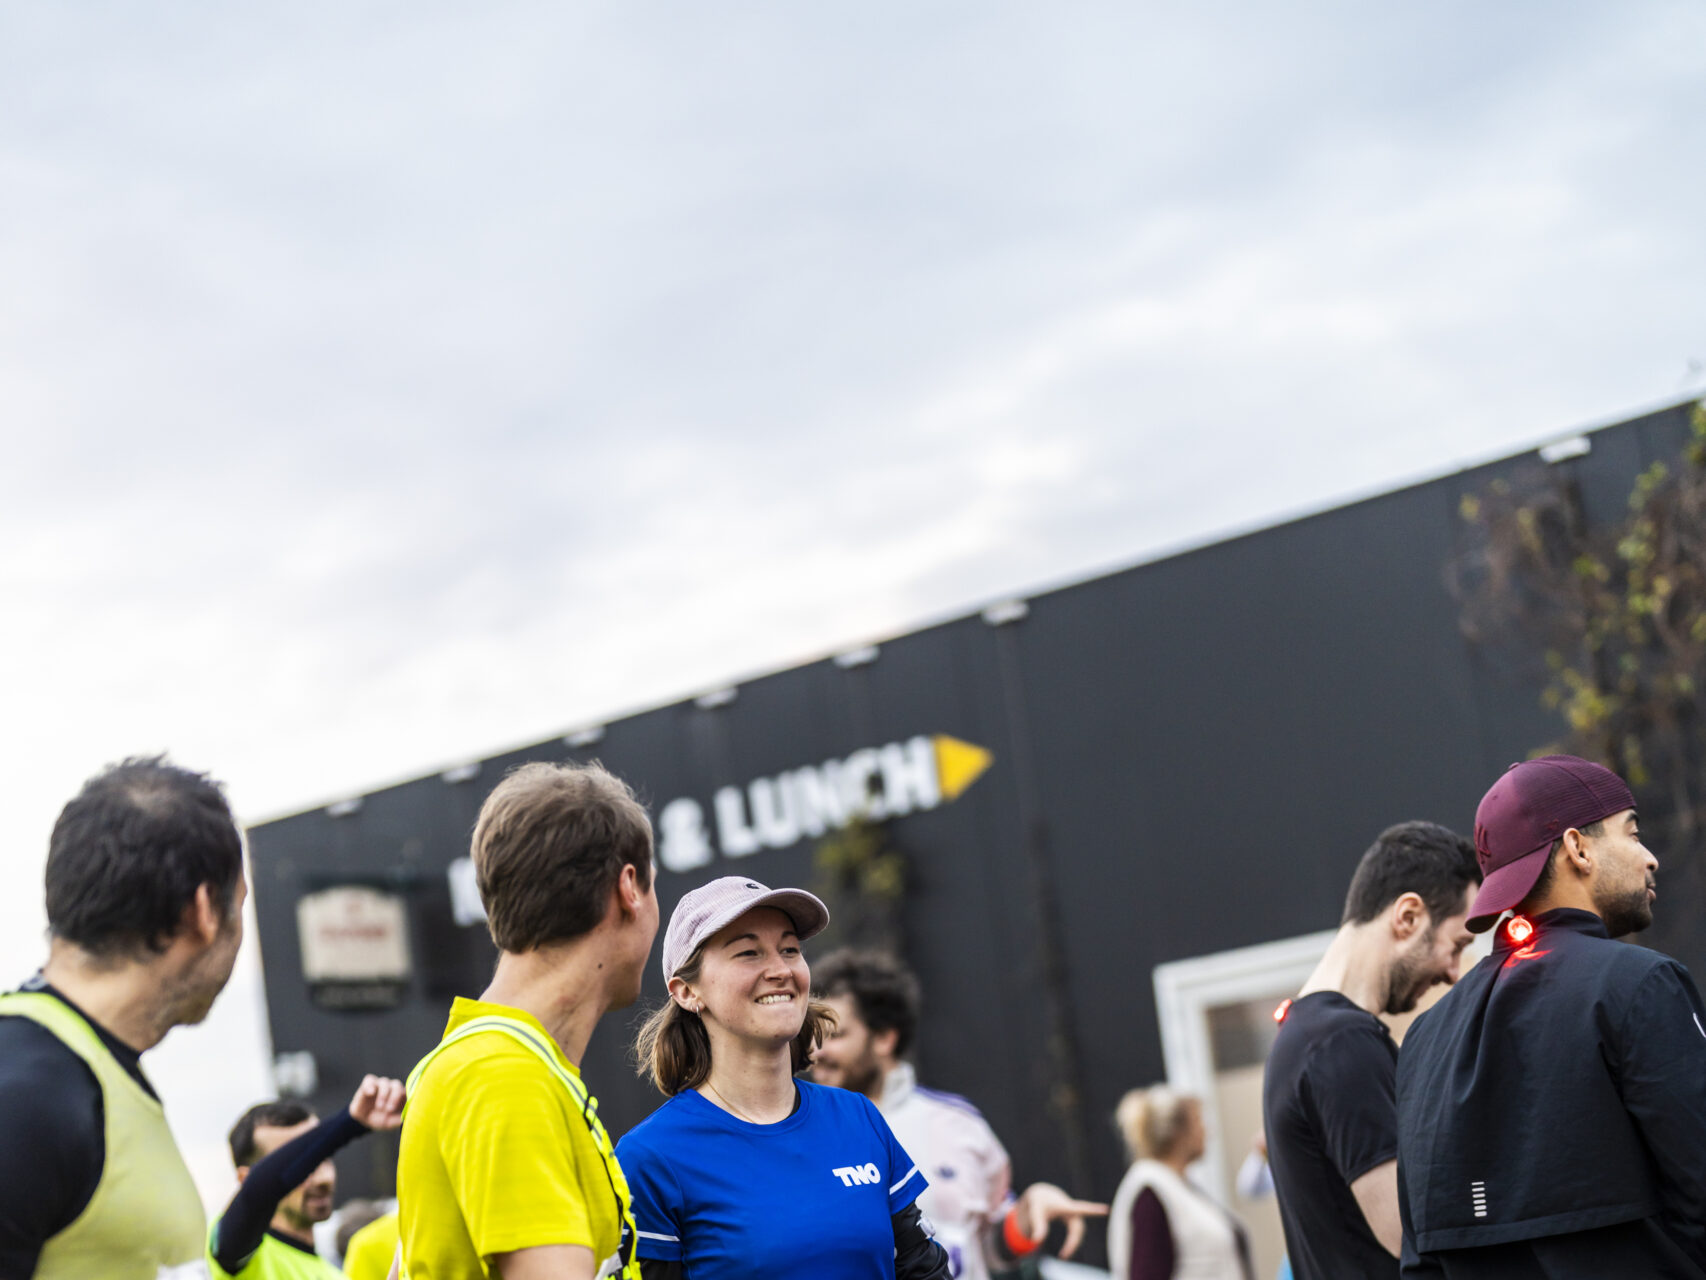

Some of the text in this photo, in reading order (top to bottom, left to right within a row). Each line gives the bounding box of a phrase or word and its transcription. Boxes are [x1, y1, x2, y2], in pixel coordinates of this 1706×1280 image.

[659, 736, 941, 872] & LUNCH
[832, 1162, 881, 1187] TNO
